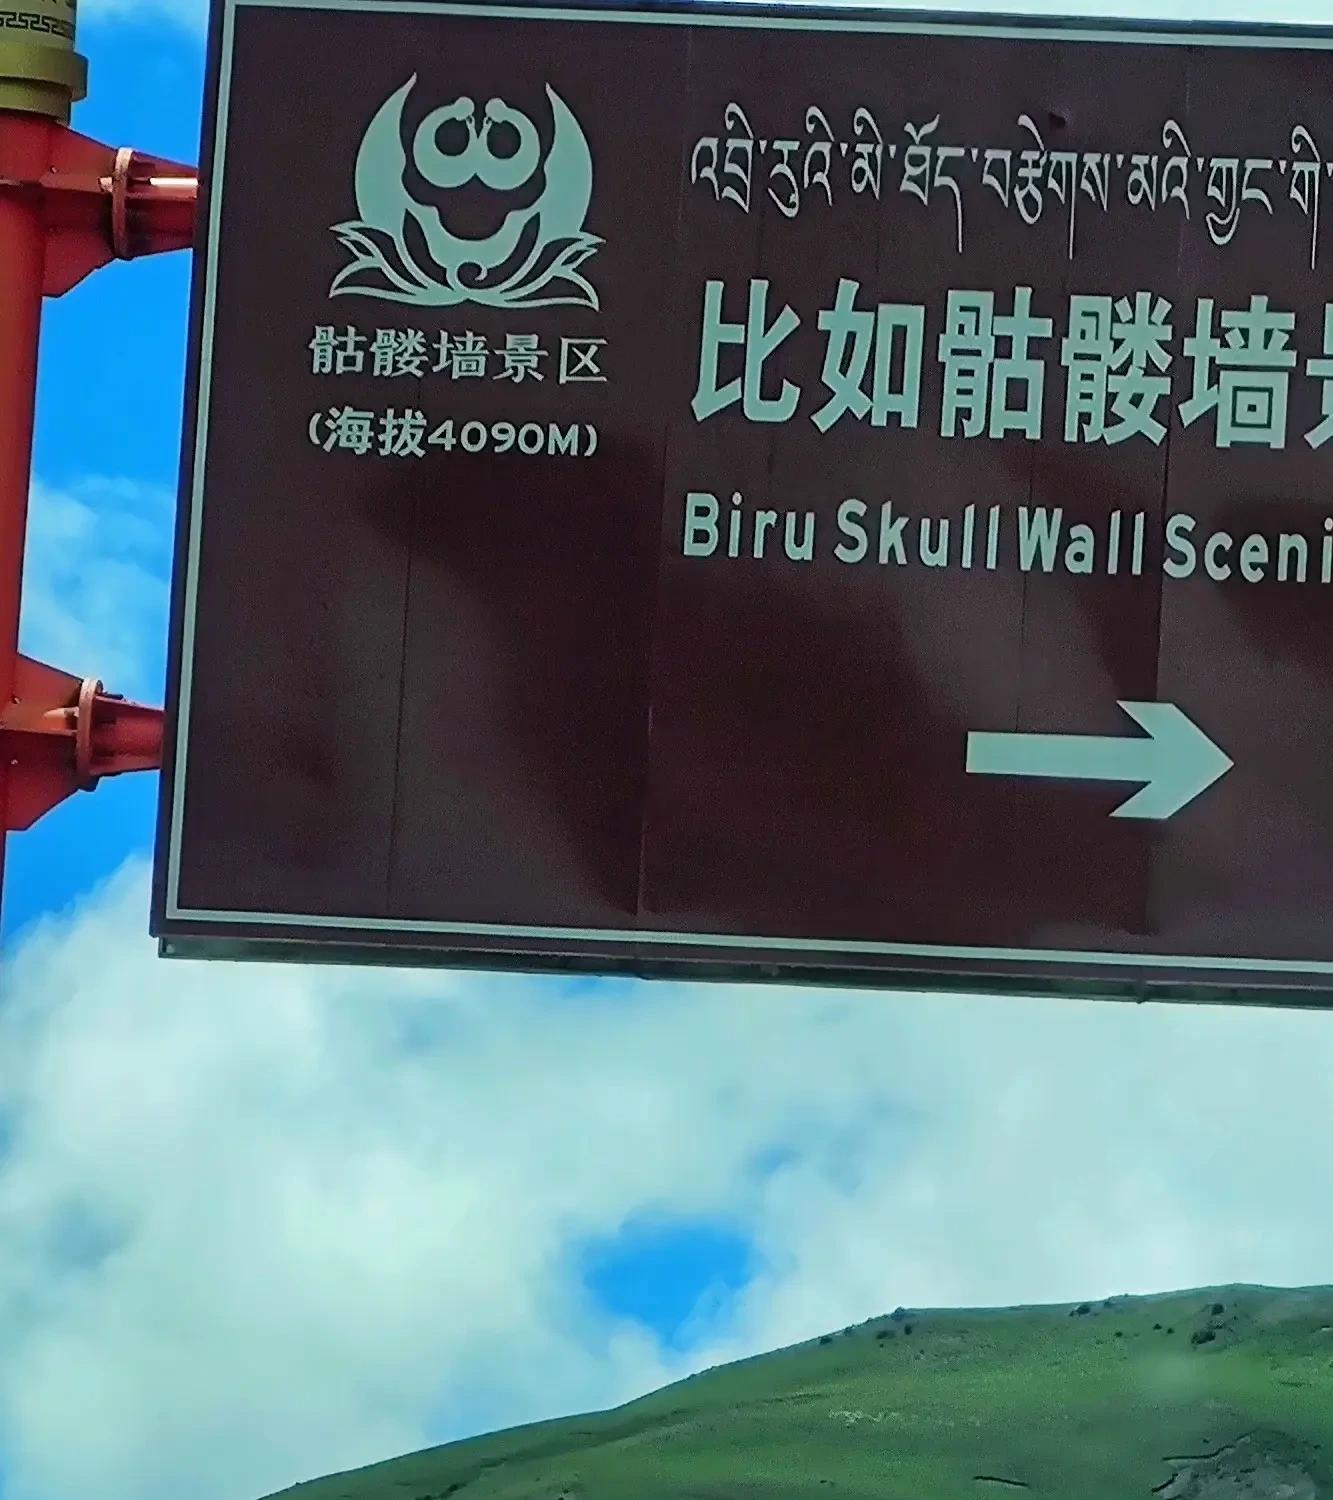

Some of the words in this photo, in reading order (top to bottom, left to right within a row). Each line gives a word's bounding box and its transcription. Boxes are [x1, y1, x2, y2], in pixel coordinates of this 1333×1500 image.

[308, 325, 609, 385] 骷髅墙景区
[309, 405, 598, 458] (海拔4090M)
[683, 491, 815, 561] Biru
[833, 498, 1000, 571] Skull
[1018, 506, 1145, 575] Wall
